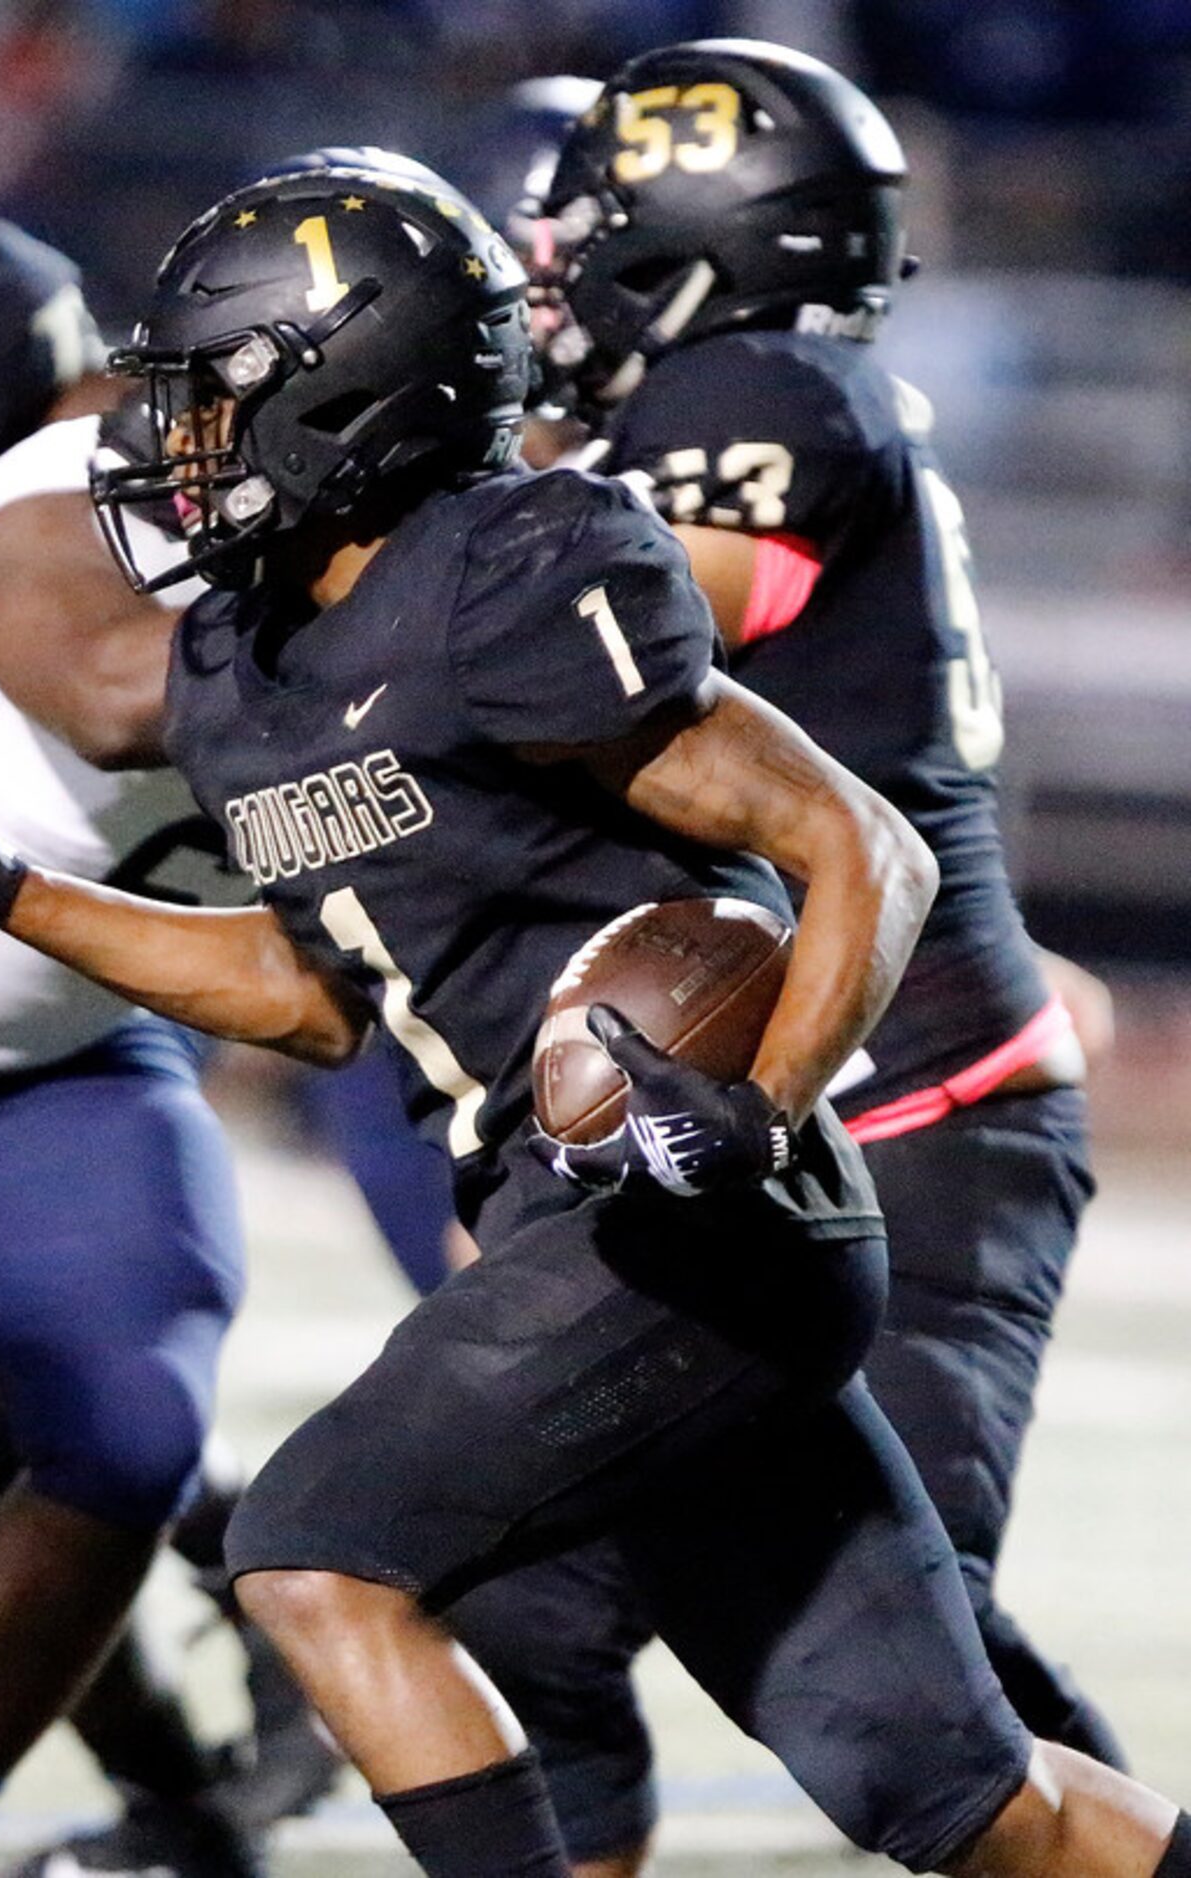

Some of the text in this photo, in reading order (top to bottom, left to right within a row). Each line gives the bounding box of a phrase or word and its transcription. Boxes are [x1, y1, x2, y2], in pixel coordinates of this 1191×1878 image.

[614, 83, 740, 183] 53
[294, 215, 349, 312] 1
[575, 585, 646, 697] 1
[225, 748, 434, 887] COUGARS
[320, 886, 487, 1159] 1
